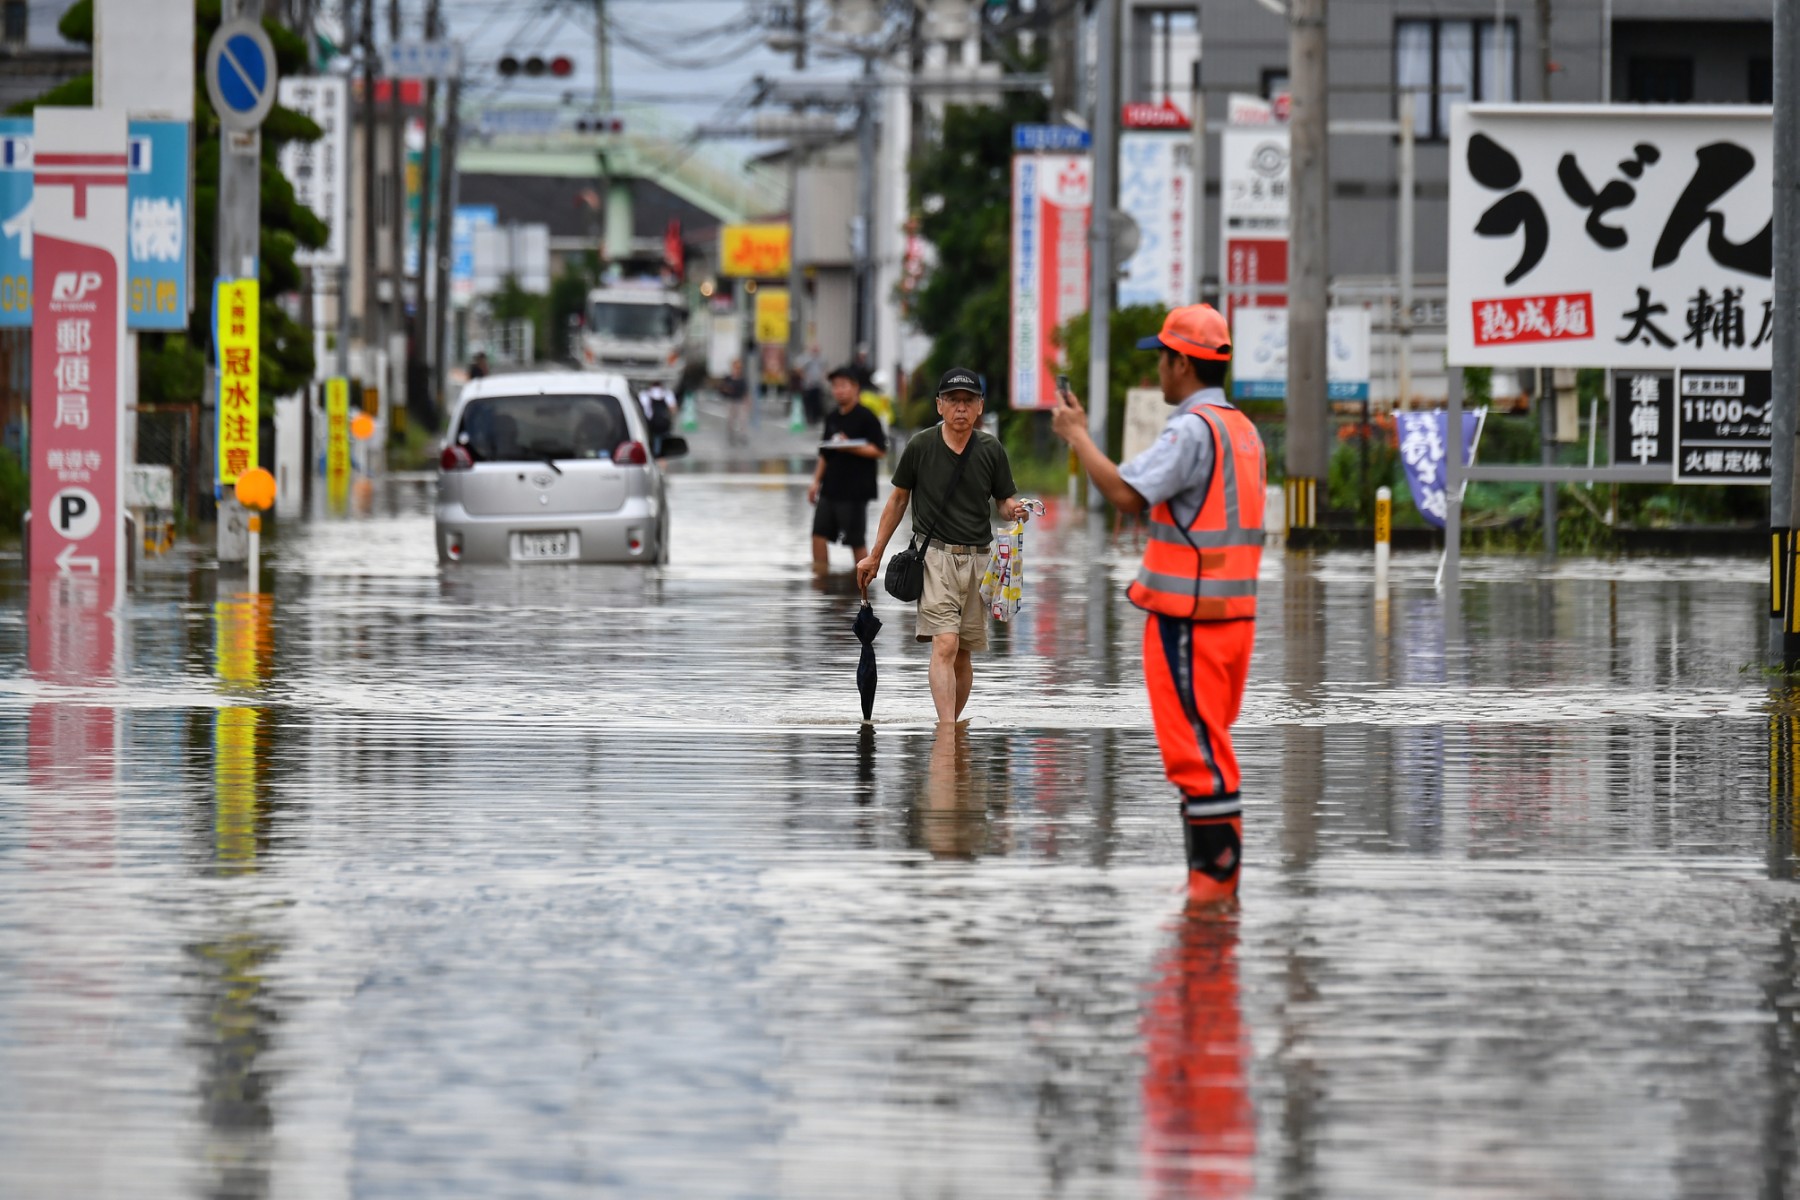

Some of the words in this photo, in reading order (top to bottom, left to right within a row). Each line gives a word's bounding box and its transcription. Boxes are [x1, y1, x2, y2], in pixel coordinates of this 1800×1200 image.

[1466, 132, 1773, 286] うどん
[1478, 295, 1588, 341] 熟成麺
[53, 318, 91, 430] 郵便局
[225, 347, 251, 477] 冠水注意
[1629, 375, 1660, 465] 準備中
[60, 496, 87, 531] P
